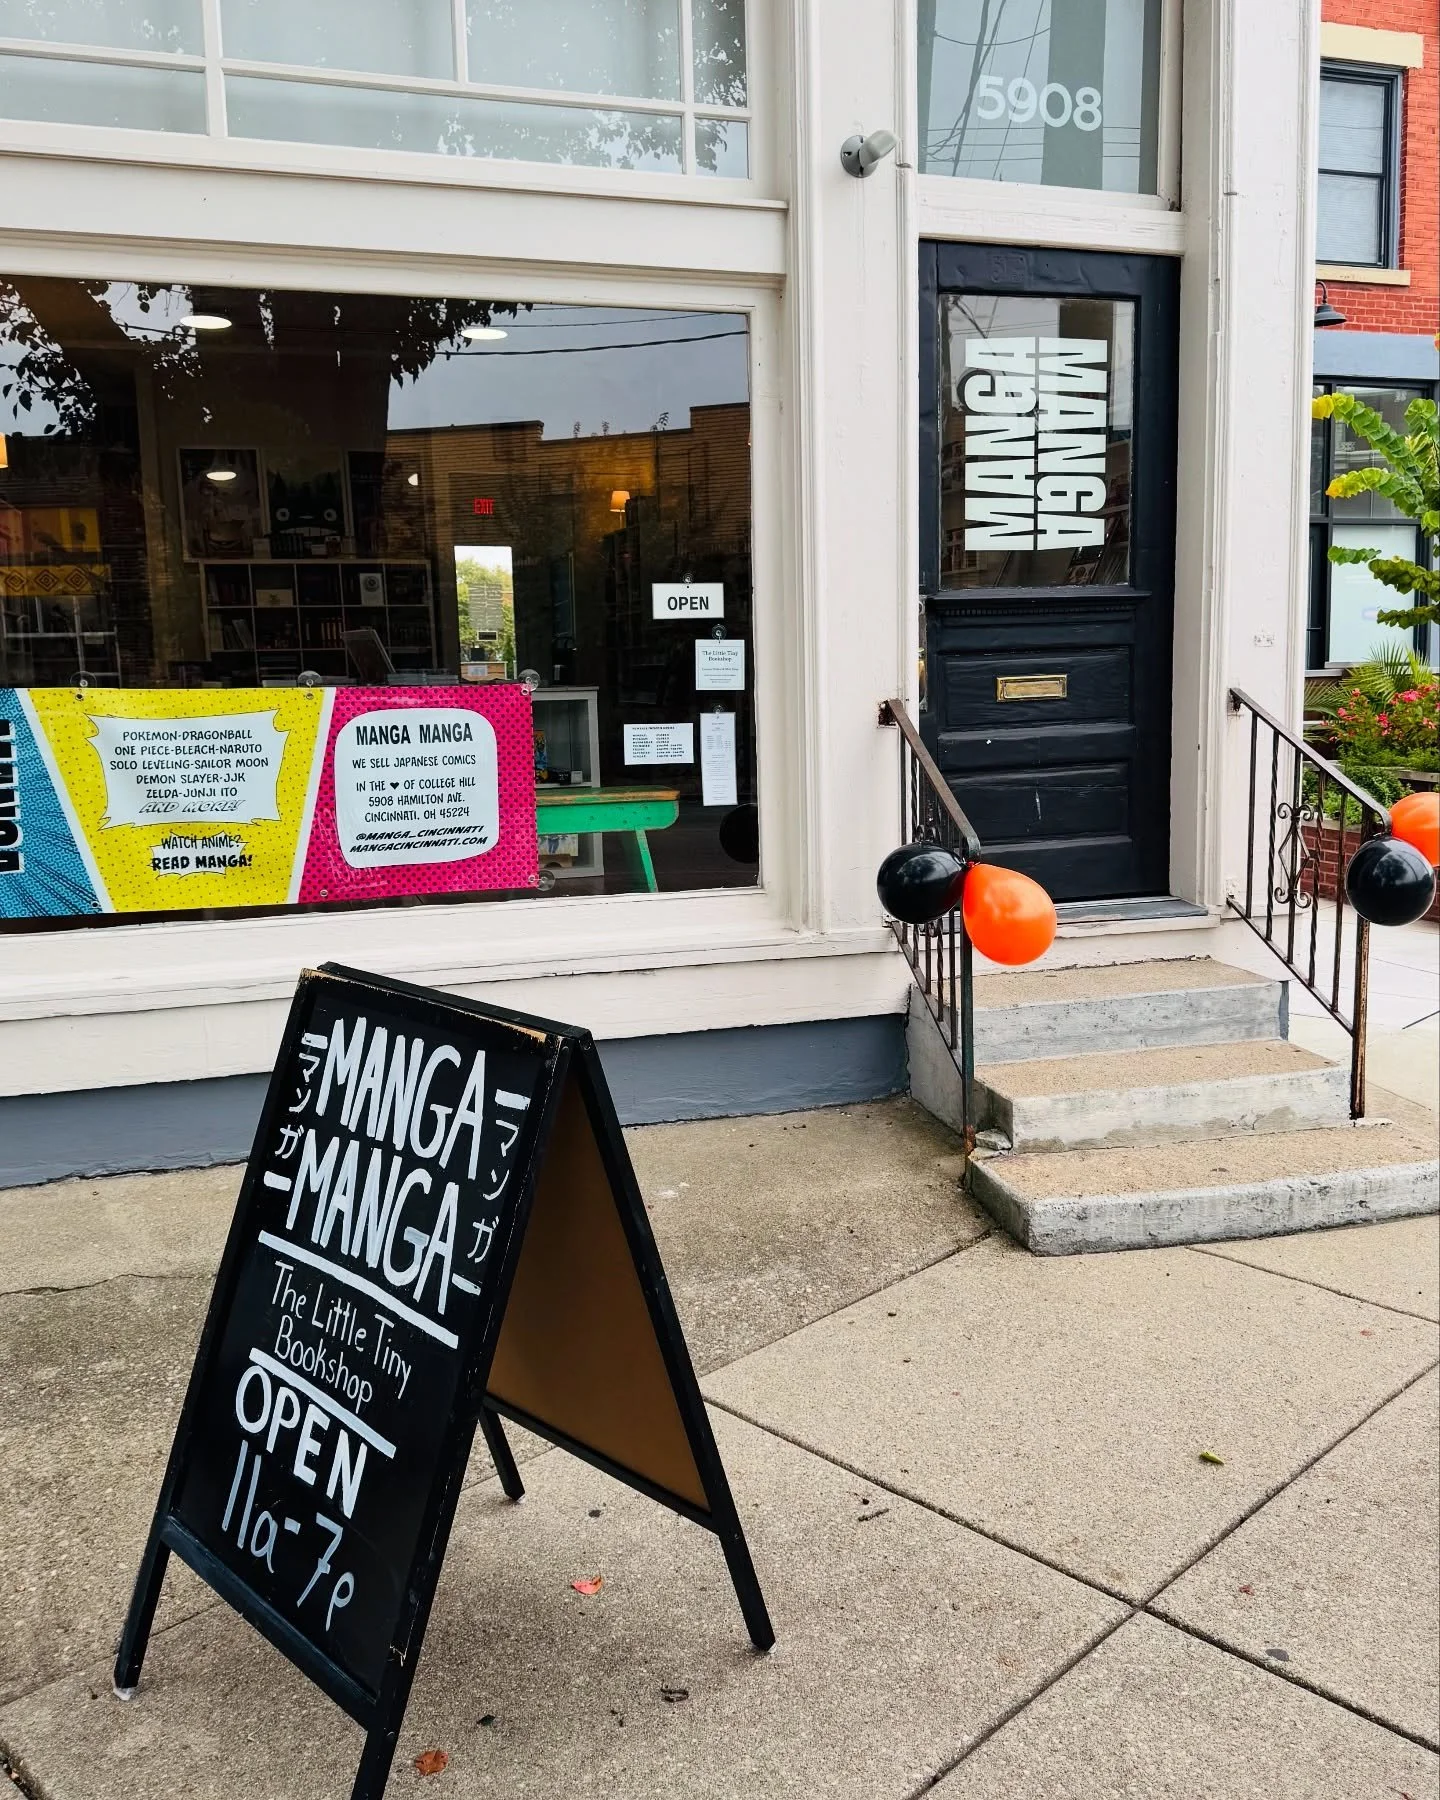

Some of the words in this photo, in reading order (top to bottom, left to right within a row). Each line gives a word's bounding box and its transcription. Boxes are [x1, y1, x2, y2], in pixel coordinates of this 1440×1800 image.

[977, 74, 1102, 132] 5908
[965, 337, 1037, 551] MANGA
[1037, 337, 1108, 551] MANGA
[474, 498, 494, 514] EXIT
[667, 596, 709, 611] OPEN
[356, 725, 411, 745] MANGA
[419, 723, 473, 743] MANGA
[115, 746, 136, 756] ONE
[110, 760, 138, 770] SOLO
[236, 757, 269, 768] MOON
[352, 758, 366, 769] WE
[370, 758, 390, 768] SELL
[394, 755, 438, 768] JAPANESE
[442, 754, 476, 766] COMICS
[136, 774, 176, 784] DEMON
[356, 781, 366, 792] IN
[369, 780, 386, 791] THE
[404, 779, 415, 790] OF
[419, 777, 455, 789] COLLEGE
[459, 776, 476, 787] HILL
[221, 787, 238, 797] ITO
[369, 796, 394, 807] 5908
[397, 793, 444, 806] HAMILTON
[447, 792, 465, 804] AVE.
[139, 801, 180, 814] AND
[423, 808, 436, 820] OH
[440, 806, 469, 818] 45224
[356, 825, 484, 841] @MANGA_CINCINNATI
[161, 835, 198, 850] WATCH
[202, 834, 242, 849] ANIME?
[349, 836, 488, 852] MANGACINCINNATI.COM
[152, 856, 190, 871] READ
[195, 855, 253, 868] MANGA!
[315, 1016, 487, 1180] MANGA
[286, 1128, 460, 1315] MANGA
[272, 1260, 307, 1319] The
[312, 1284, 366, 1352] Little
[373, 1314, 411, 1399] Tiny
[274, 1315, 372, 1413] Bookshop
[235, 1365, 368, 1519] OPEN
